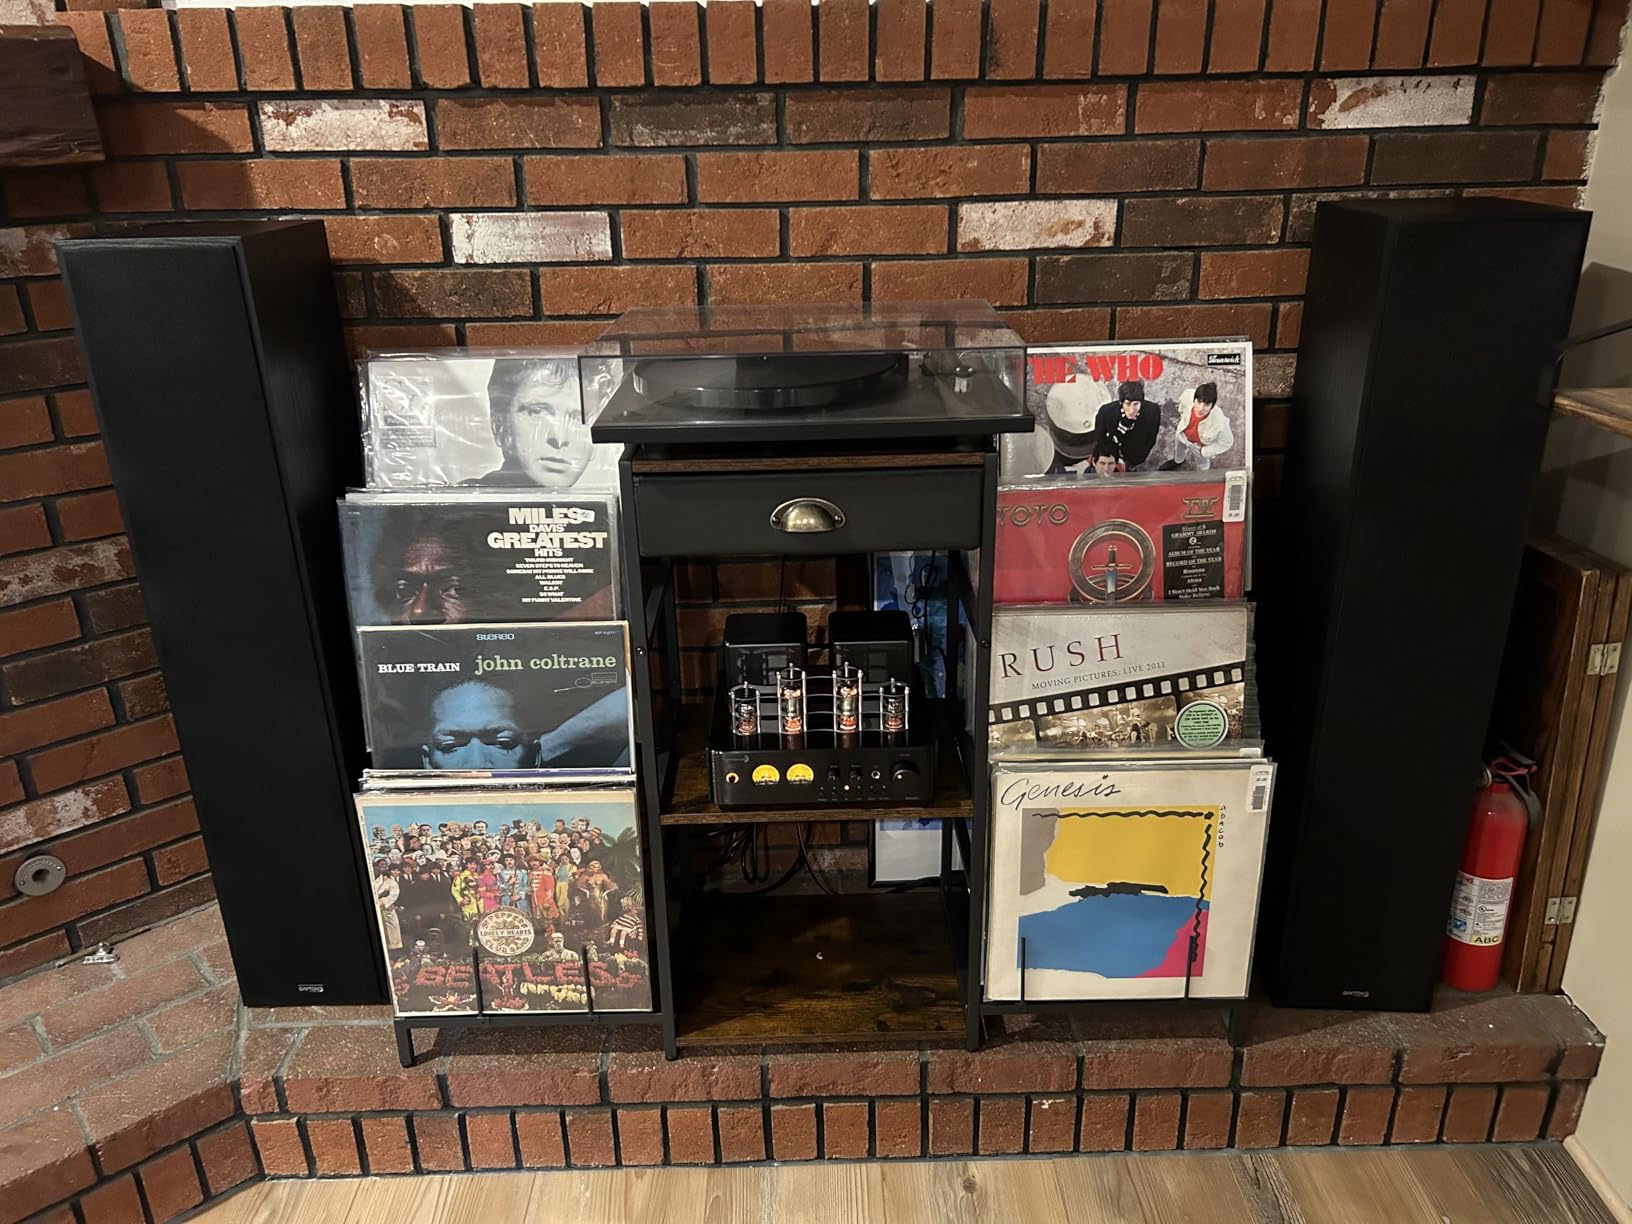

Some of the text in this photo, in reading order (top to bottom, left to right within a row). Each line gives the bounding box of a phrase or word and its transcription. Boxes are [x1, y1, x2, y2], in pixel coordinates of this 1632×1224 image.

[1085, 353, 1164, 383] WHO
[508, 507, 584, 525] MILES
[996, 503, 1070, 528] TOTO
[487, 531, 608, 549] GREATEST
[534, 548, 563, 557] HITS
[377, 662, 462, 674] BLUE TRAIN
[475, 653, 617, 676] john coltrane
[998, 633, 1125, 679] RUSH
[1031, 661, 1167, 690] MOVING PICTURES: LIVE 2011
[1000, 774, 1123, 811] Genesis
[1474, 936, 1499, 944] ABC
[415, 960, 616, 988] BEATLES
